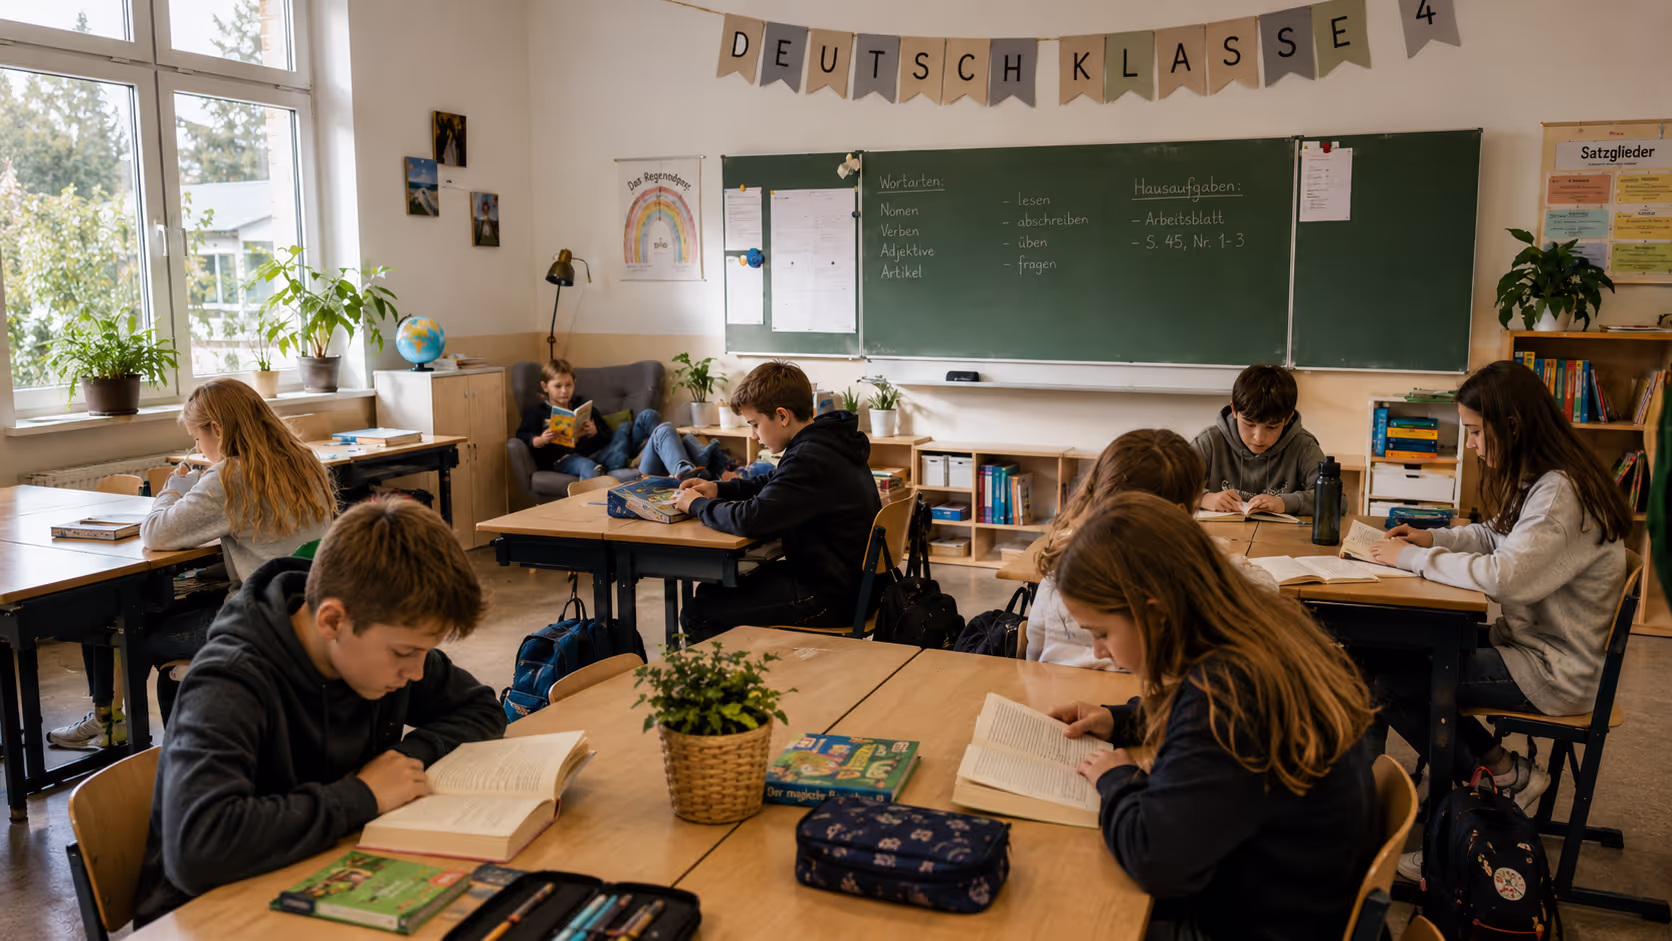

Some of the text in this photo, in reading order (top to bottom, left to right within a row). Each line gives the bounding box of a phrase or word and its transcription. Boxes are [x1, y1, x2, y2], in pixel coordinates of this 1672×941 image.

[731, 0, 1437, 83] DEUTSCH KLASSE 4
[1581, 144, 1655, 162] Satzglieder
[627, 177, 642, 191] Das
[880, 173, 944, 189] Wortarten:
[1134, 175, 1241, 202] Hausaufgaben:
[1018, 191, 1051, 207] lesen
[880, 202, 919, 217] Nomen
[1145, 209, 1225, 226] Arbeitsblatt
[1017, 211, 1089, 228] abschreiben
[880, 223, 920, 237] Verben
[1018, 236, 1048, 248] üben
[1145, 234, 1159, 249] S.
[1165, 233, 1187, 251] 45,
[1193, 233, 1212, 248] Nr.
[880, 243, 935, 262] Adjektive
[880, 264, 922, 279] Artikel
[1018, 254, 1057, 275] fragen
